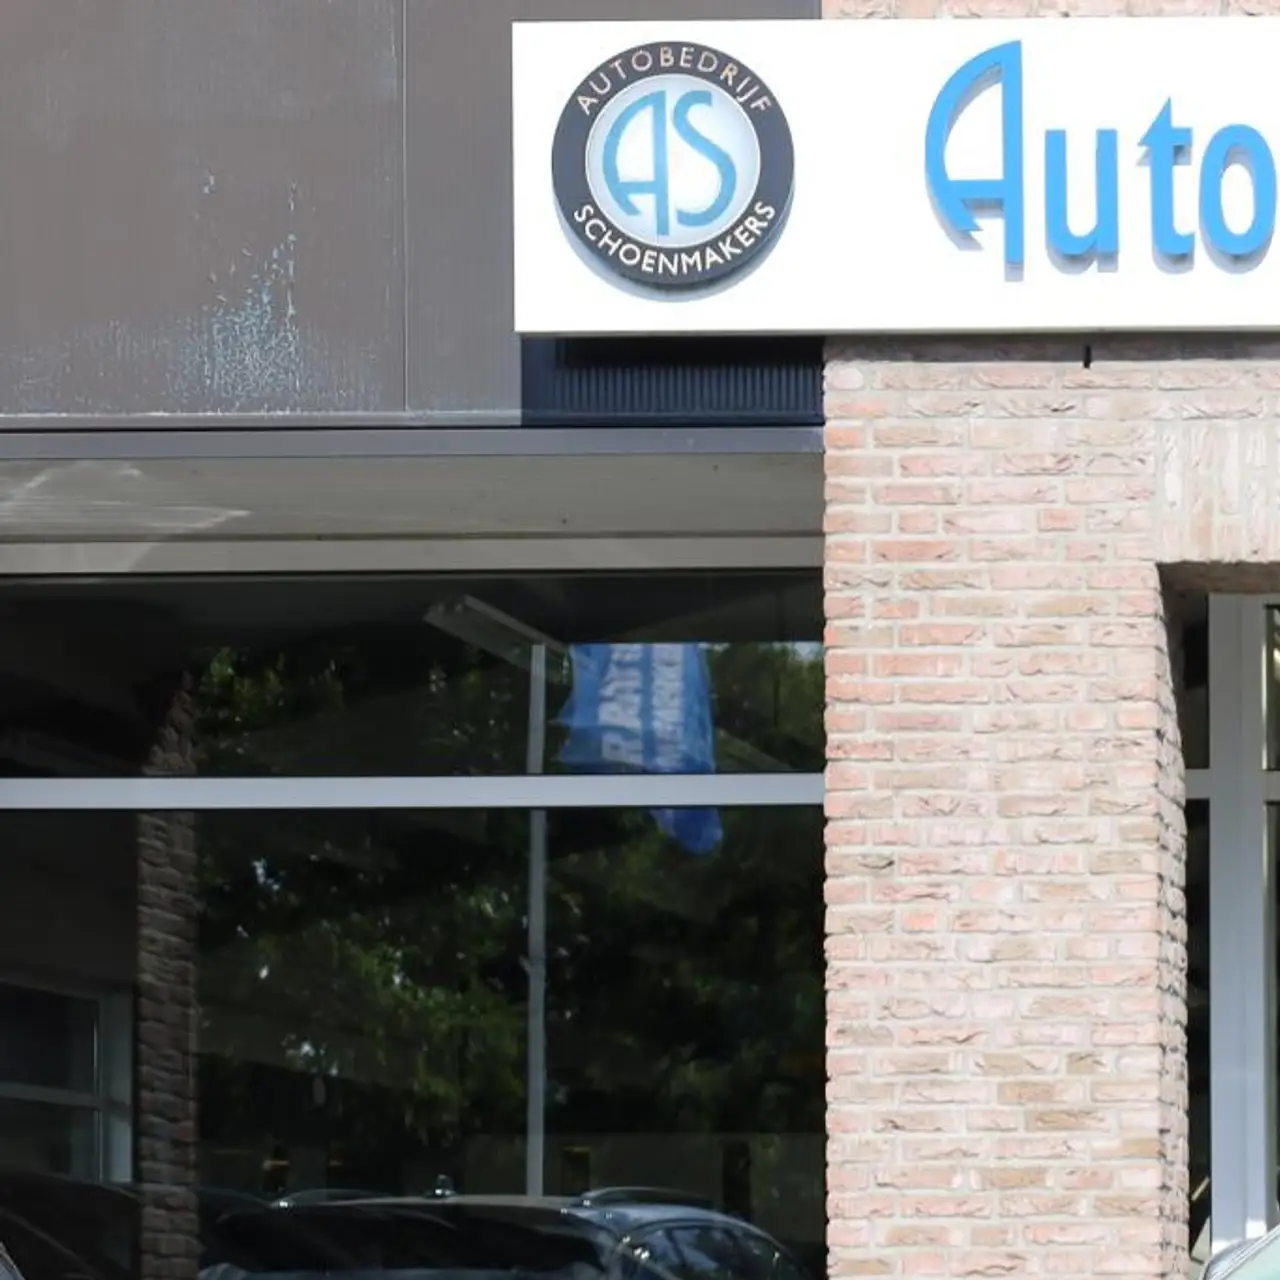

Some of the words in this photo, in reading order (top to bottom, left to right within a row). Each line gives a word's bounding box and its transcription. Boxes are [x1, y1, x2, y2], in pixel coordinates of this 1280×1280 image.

[577, 46, 772, 115] AUTOBEDRIJF
[602, 90, 737, 237] AS
[574, 201, 776, 276] SCHOENMAKERS
